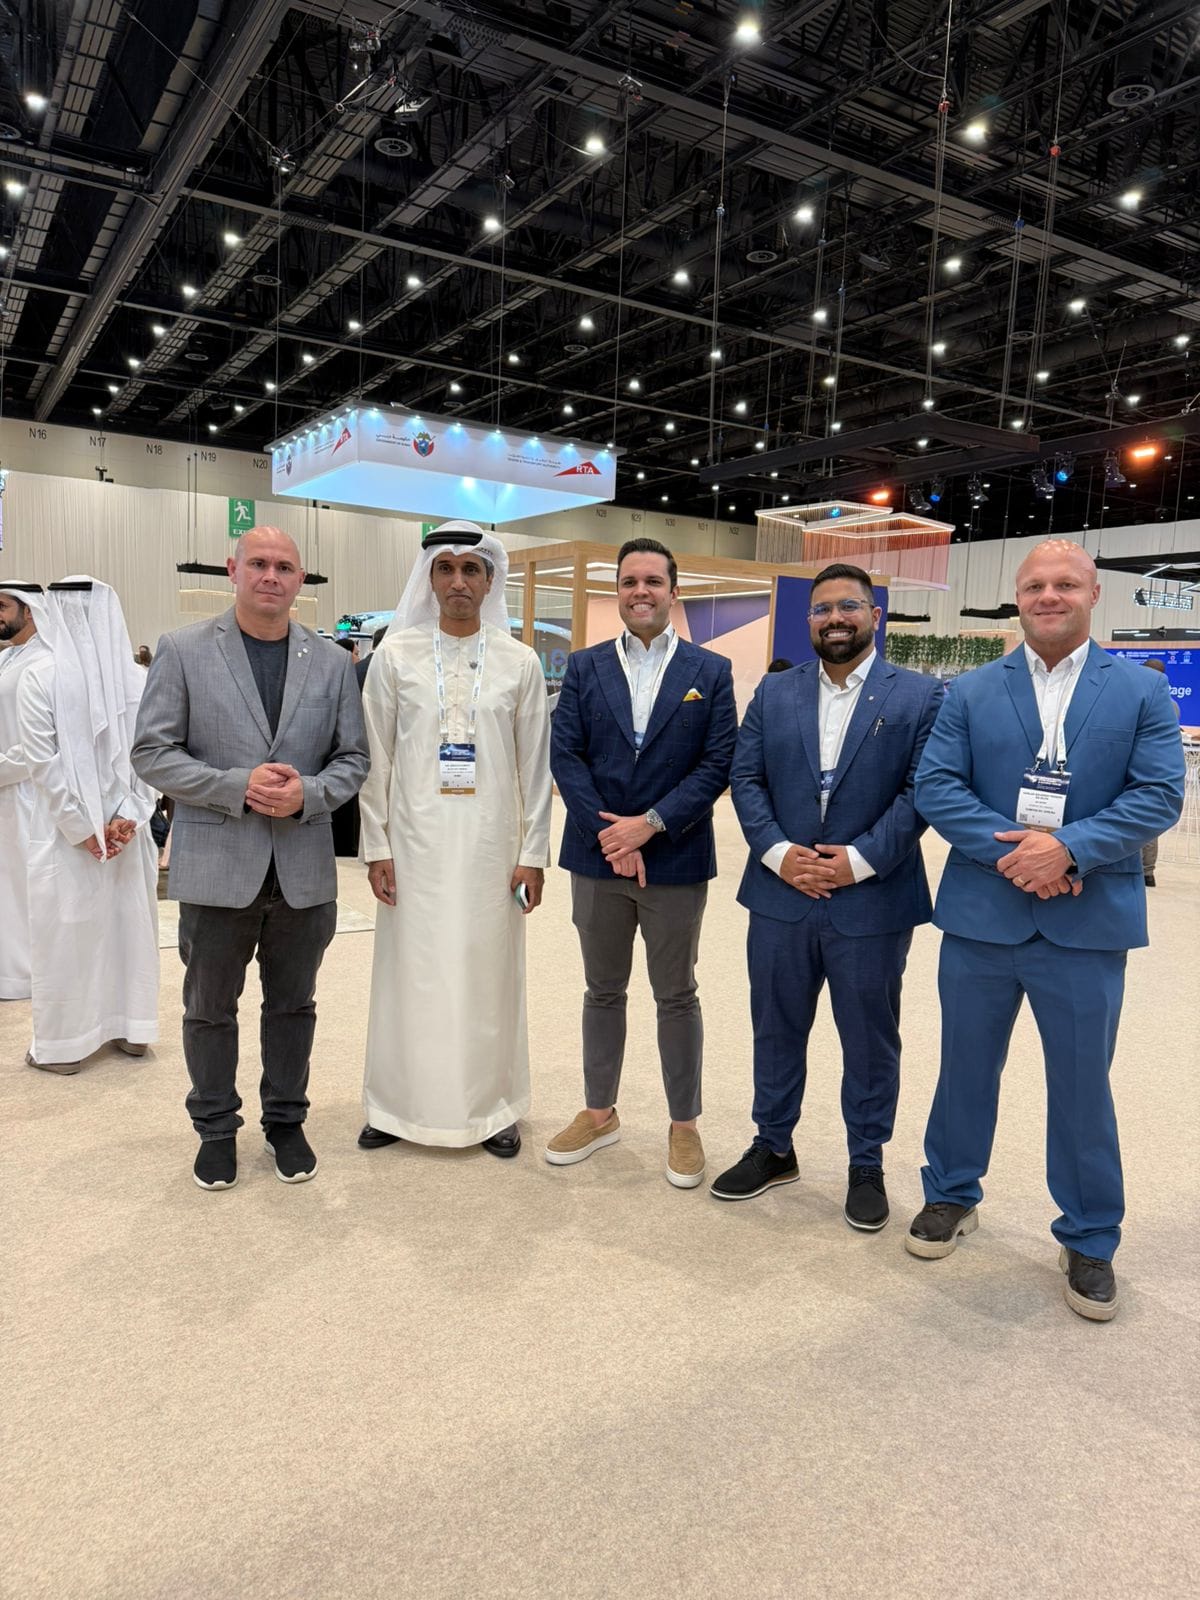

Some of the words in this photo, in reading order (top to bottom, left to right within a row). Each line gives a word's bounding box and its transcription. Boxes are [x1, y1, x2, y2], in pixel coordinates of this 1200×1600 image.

[29, 427, 47, 440] N16
[90, 436, 106, 448] N17
[146, 444, 162, 456] N18
[201, 451, 217, 462] N19
[252, 458, 268, 470] N20
[576, 465, 594, 475] RTA
